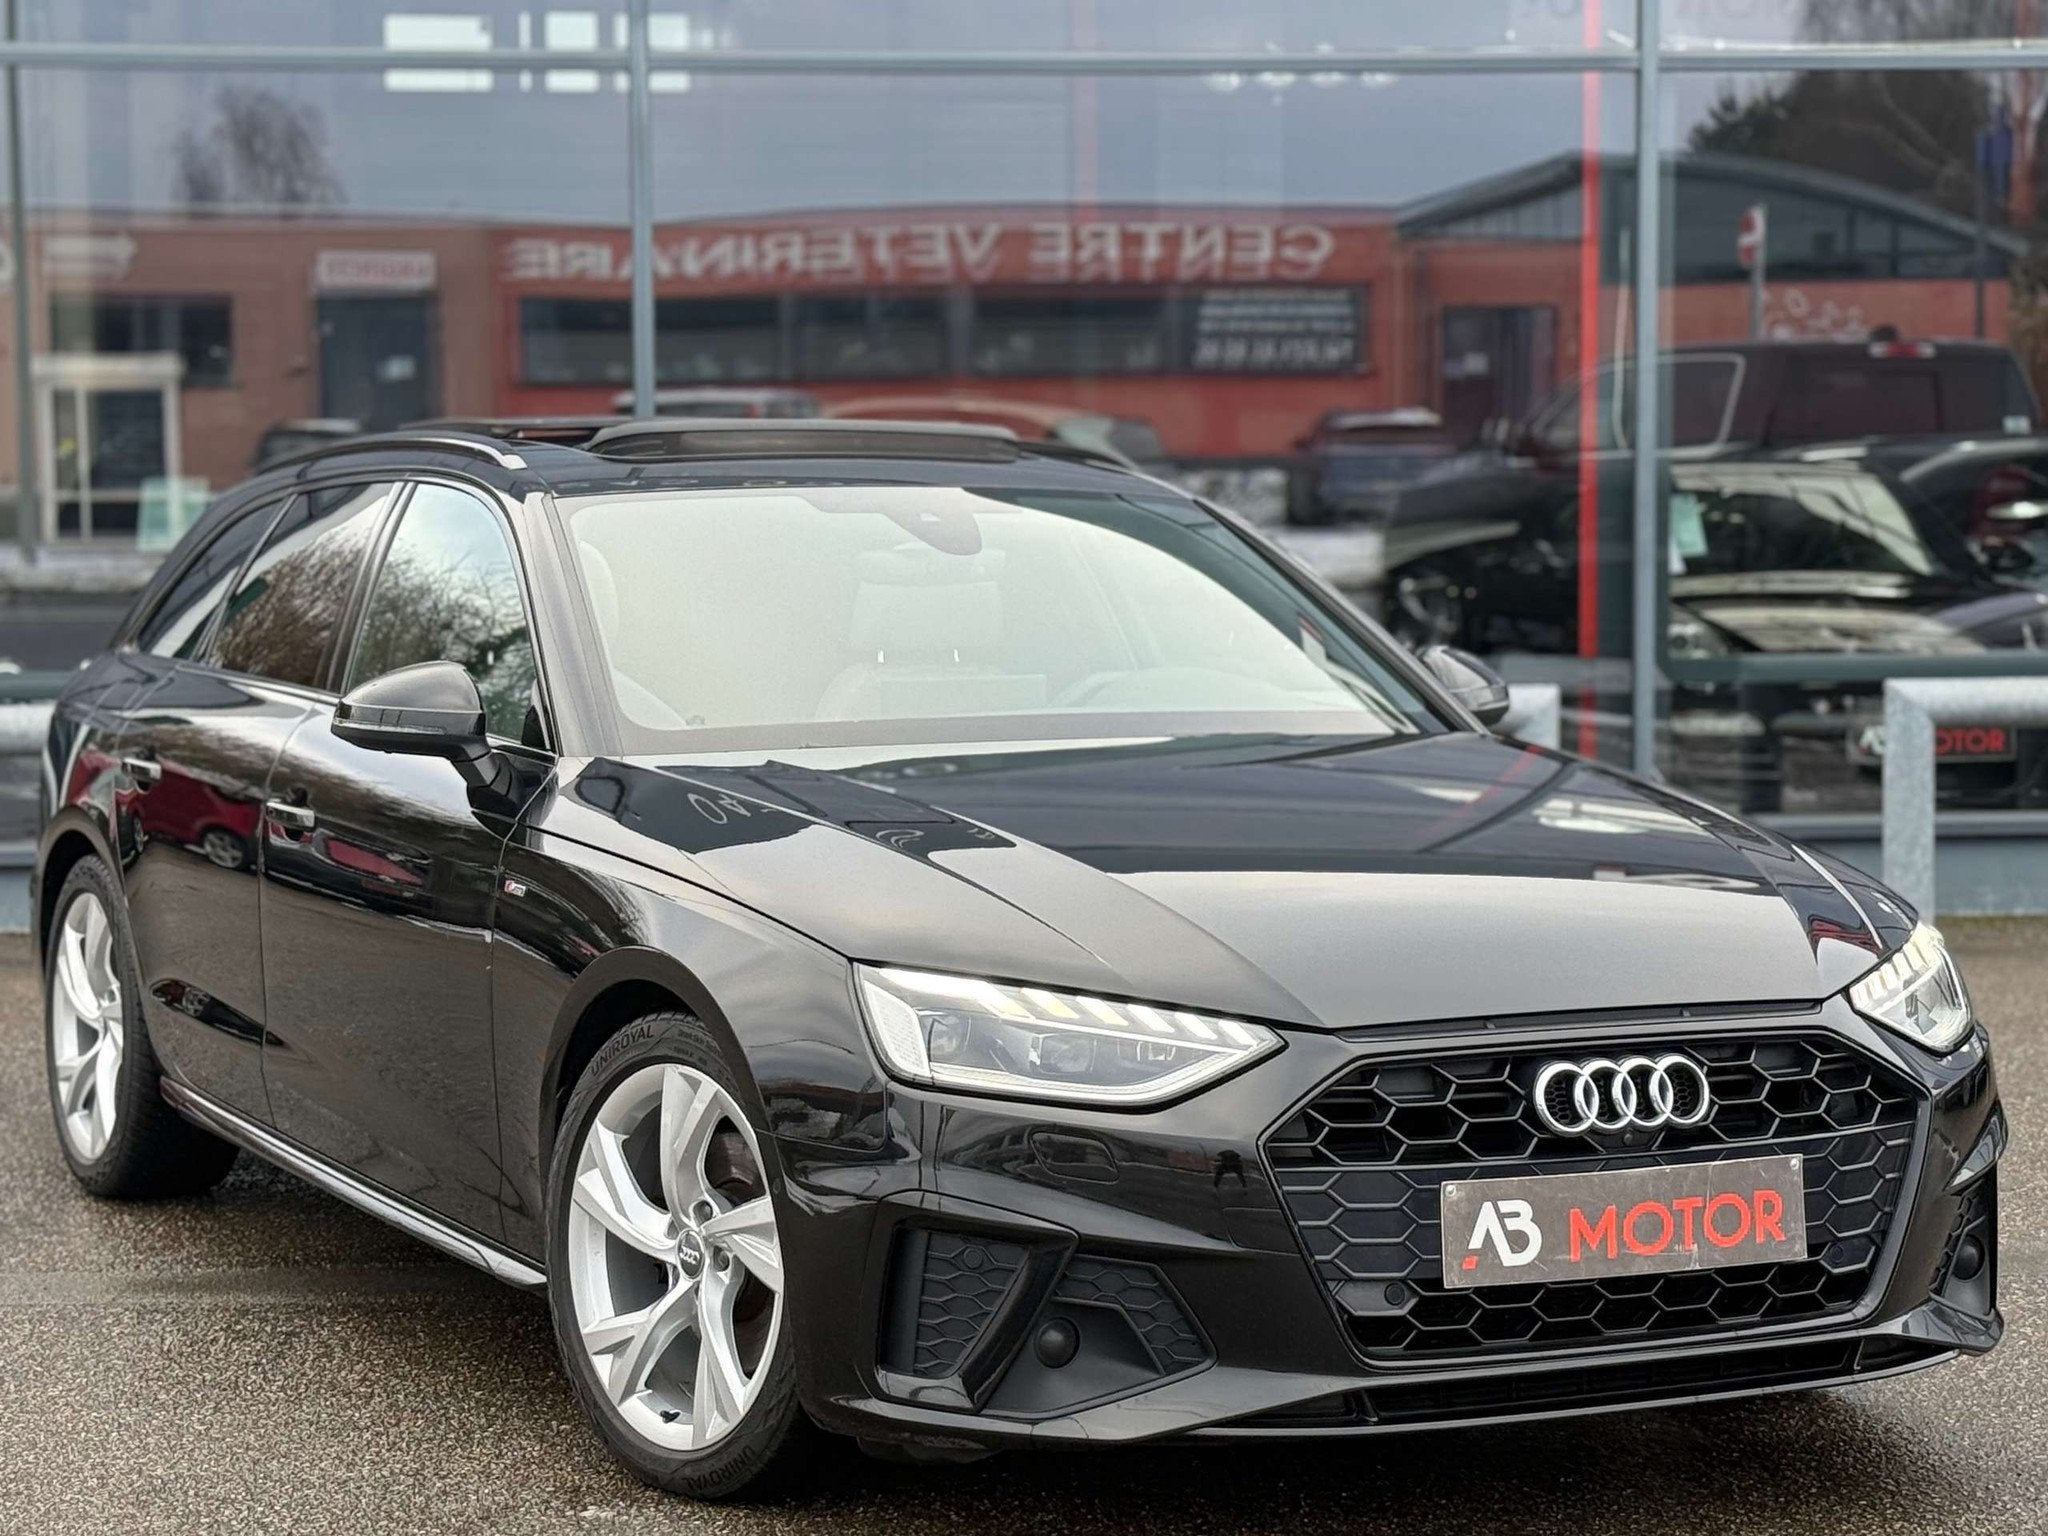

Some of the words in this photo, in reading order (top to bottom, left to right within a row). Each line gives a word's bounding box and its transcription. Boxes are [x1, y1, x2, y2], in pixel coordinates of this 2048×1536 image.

[1934, 726, 2007, 754] OTOR
[589, 1024, 654, 1077] UNIROYAL
[1465, 1198, 1543, 1267] AB
[1569, 1188, 1787, 1264] MOTOR
[682, 1444, 757, 1492] UNIROYAL
